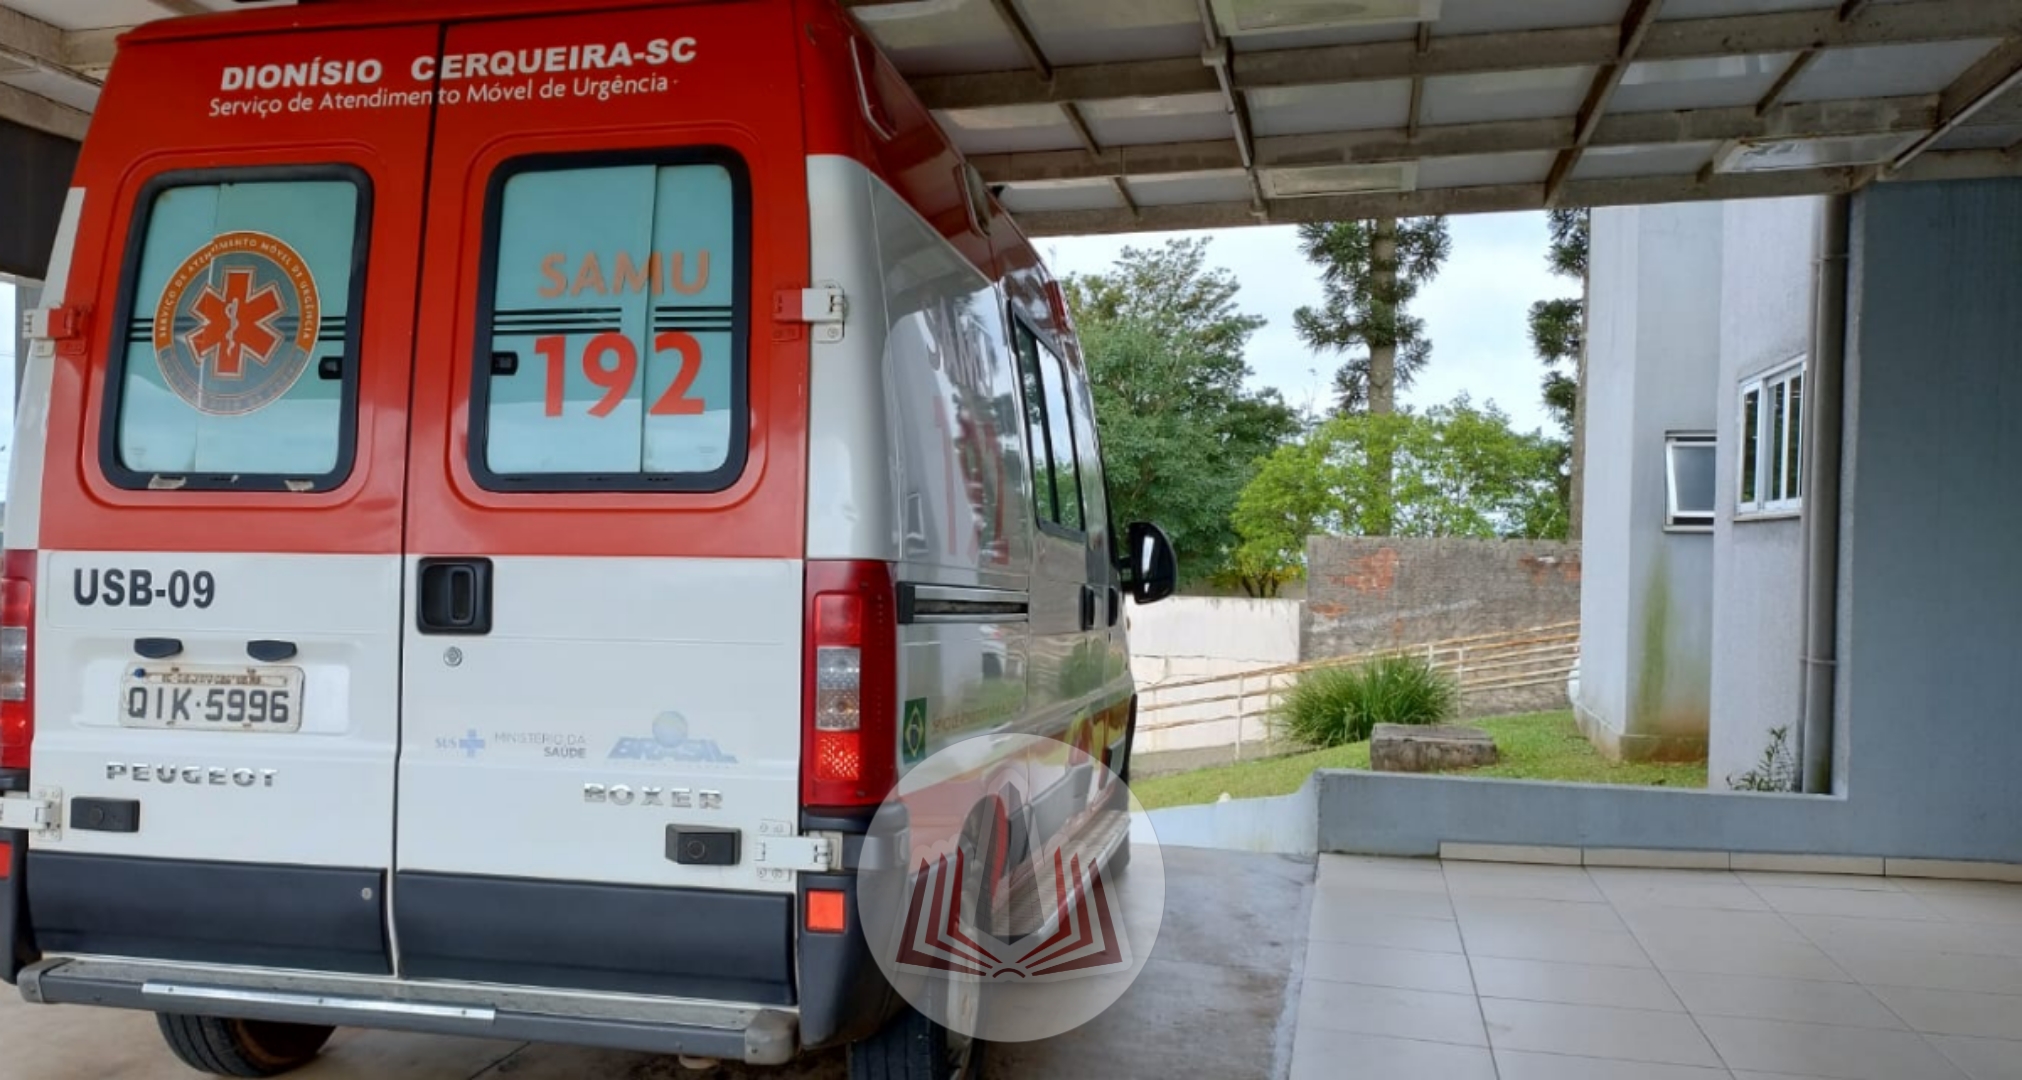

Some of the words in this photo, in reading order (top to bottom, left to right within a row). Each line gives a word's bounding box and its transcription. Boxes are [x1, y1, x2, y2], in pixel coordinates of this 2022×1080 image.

[220, 57, 383, 91] DIONÍSIO
[410, 37, 697, 81] CERQUEIRA-SC
[208, 97, 283, 118] Serviço
[287, 92, 314, 112] de
[318, 83, 461, 111] Atendimento
[466, 78, 534, 103] Móvel
[539, 78, 567, 99] de
[572, 72, 669, 101] Urgência
[538, 248, 710, 298] SAMU
[534, 330, 706, 418] 192
[73, 568, 215, 609] USB-09
[543, 745, 587, 759] SAÚDE
[105, 761, 278, 788] PEUGEOT
[583, 782, 723, 810] BOXER
